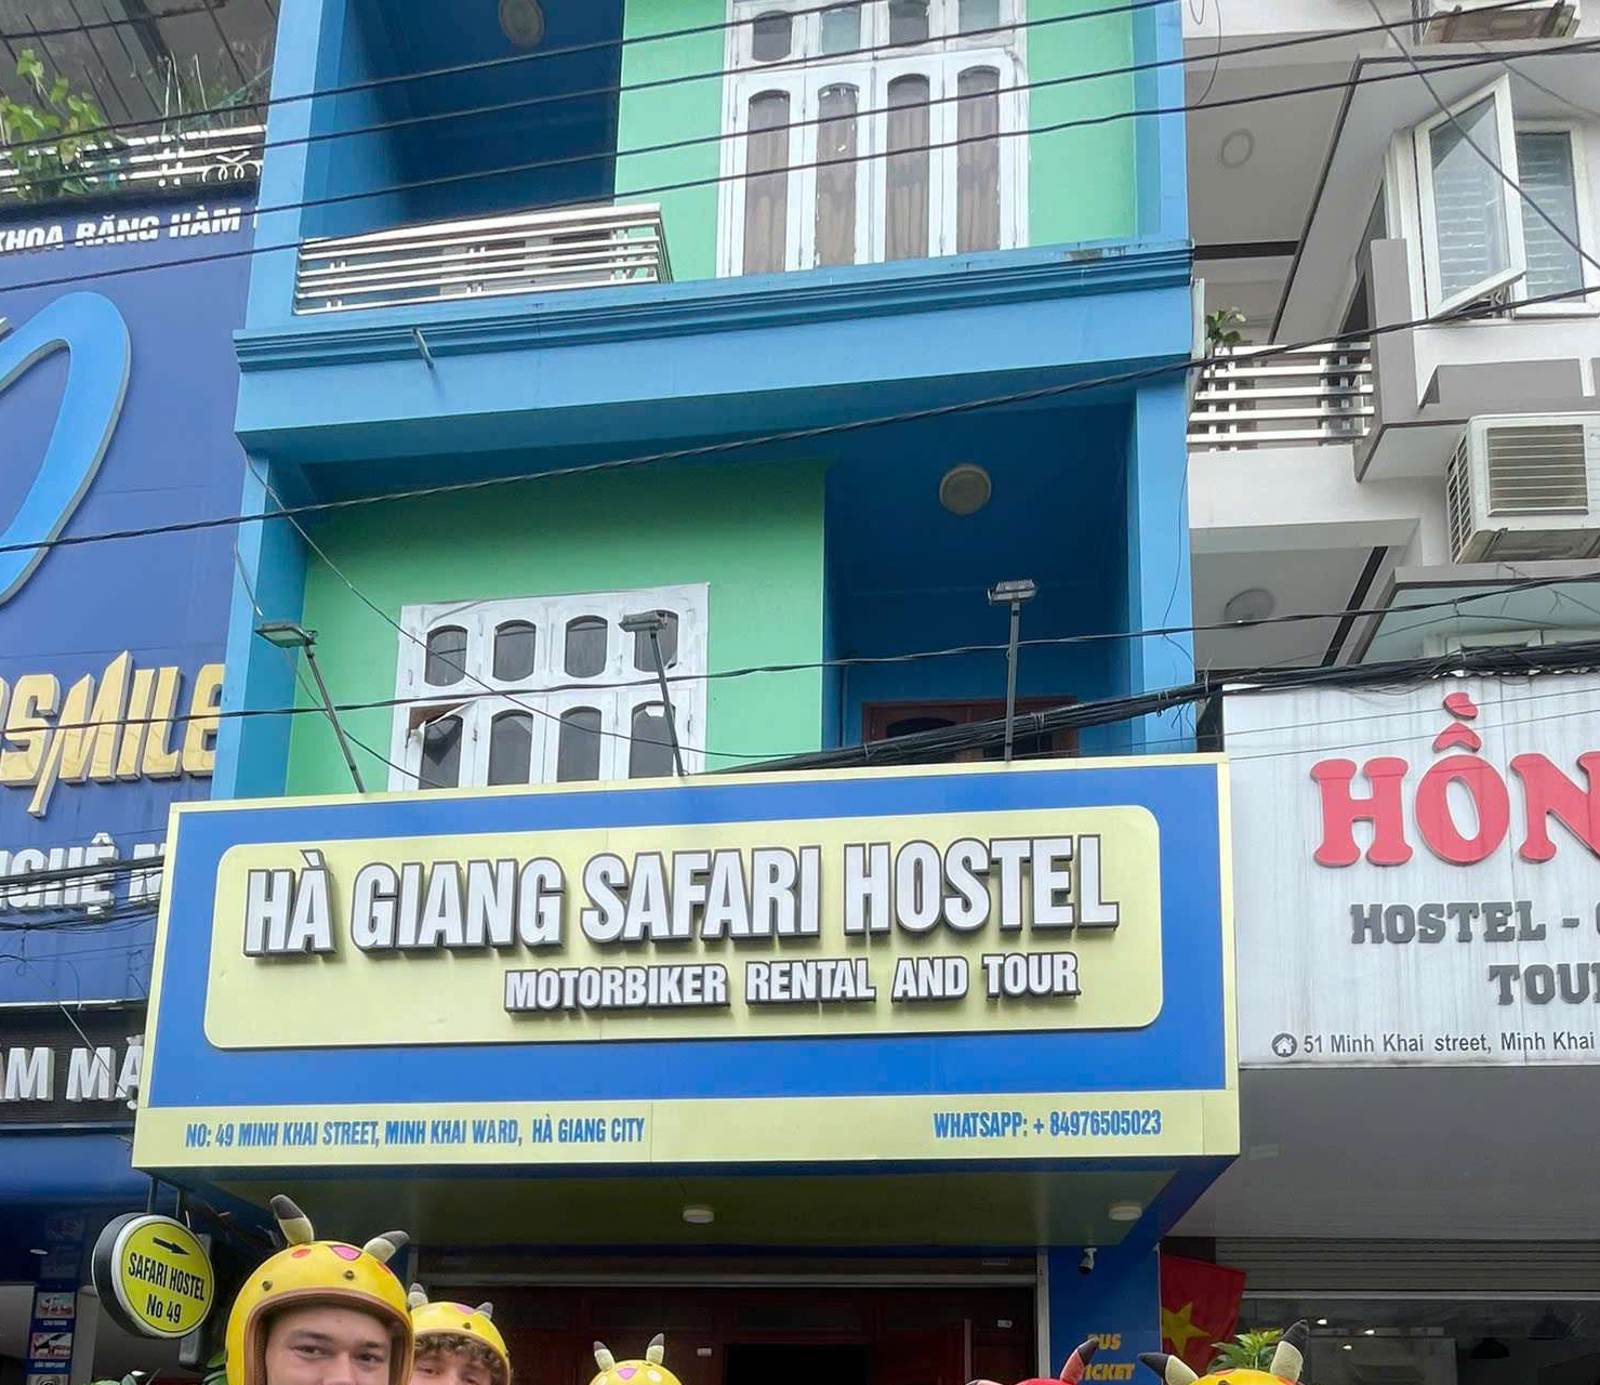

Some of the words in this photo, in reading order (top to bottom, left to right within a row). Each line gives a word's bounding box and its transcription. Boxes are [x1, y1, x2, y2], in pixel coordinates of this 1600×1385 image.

[75, 214, 160, 248] RĂNG
[0, 832, 119, 916] GHỆ
[243, 848, 337, 957] HÀ
[351, 857, 567, 951] GIANG
[580, 845, 821, 943] SAFARI
[844, 834, 1120, 935] HOSTEL
[1351, 901, 1547, 944] HOSTEL
[504, 963, 731, 1013] MOTORBIKER
[746, 957, 876, 1005] RENTAL
[891, 955, 970, 1003] AND
[982, 952, 1081, 998] TOUR
[1303, 1035, 1323, 1052] 51
[1331, 1033, 1374, 1053] Minh
[1383, 1033, 1424, 1052] Khai
[1434, 1033, 1492, 1054] street,
[1501, 1031, 1546, 1050] Minh
[1553, 1031, 1595, 1050] Khai
[186, 1123, 212, 1147] NO:
[216, 1123, 235, 1147] 49
[238, 1122, 279, 1146] MINH
[282, 1121, 318, 1146] KHAI
[323, 1120, 380, 1148] STREET,
[385, 1120, 427, 1145] MINH
[430, 1119, 467, 1144] KHAI
[472, 1118, 523, 1147] WARD,
[532, 1113, 554, 1143] HÀ
[558, 1118, 607, 1144] GIANG
[611, 1117, 646, 1143] CITY
[934, 1112, 1028, 1138] WHATSAPP:
[1050, 1109, 1162, 1136] 84976505023
[128, 1252, 168, 1289] SAFARI
[169, 1267, 205, 1301] HOSTEL
[166, 1301, 182, 1324] 49
[1084, 1363, 1136, 1381] ICKET
